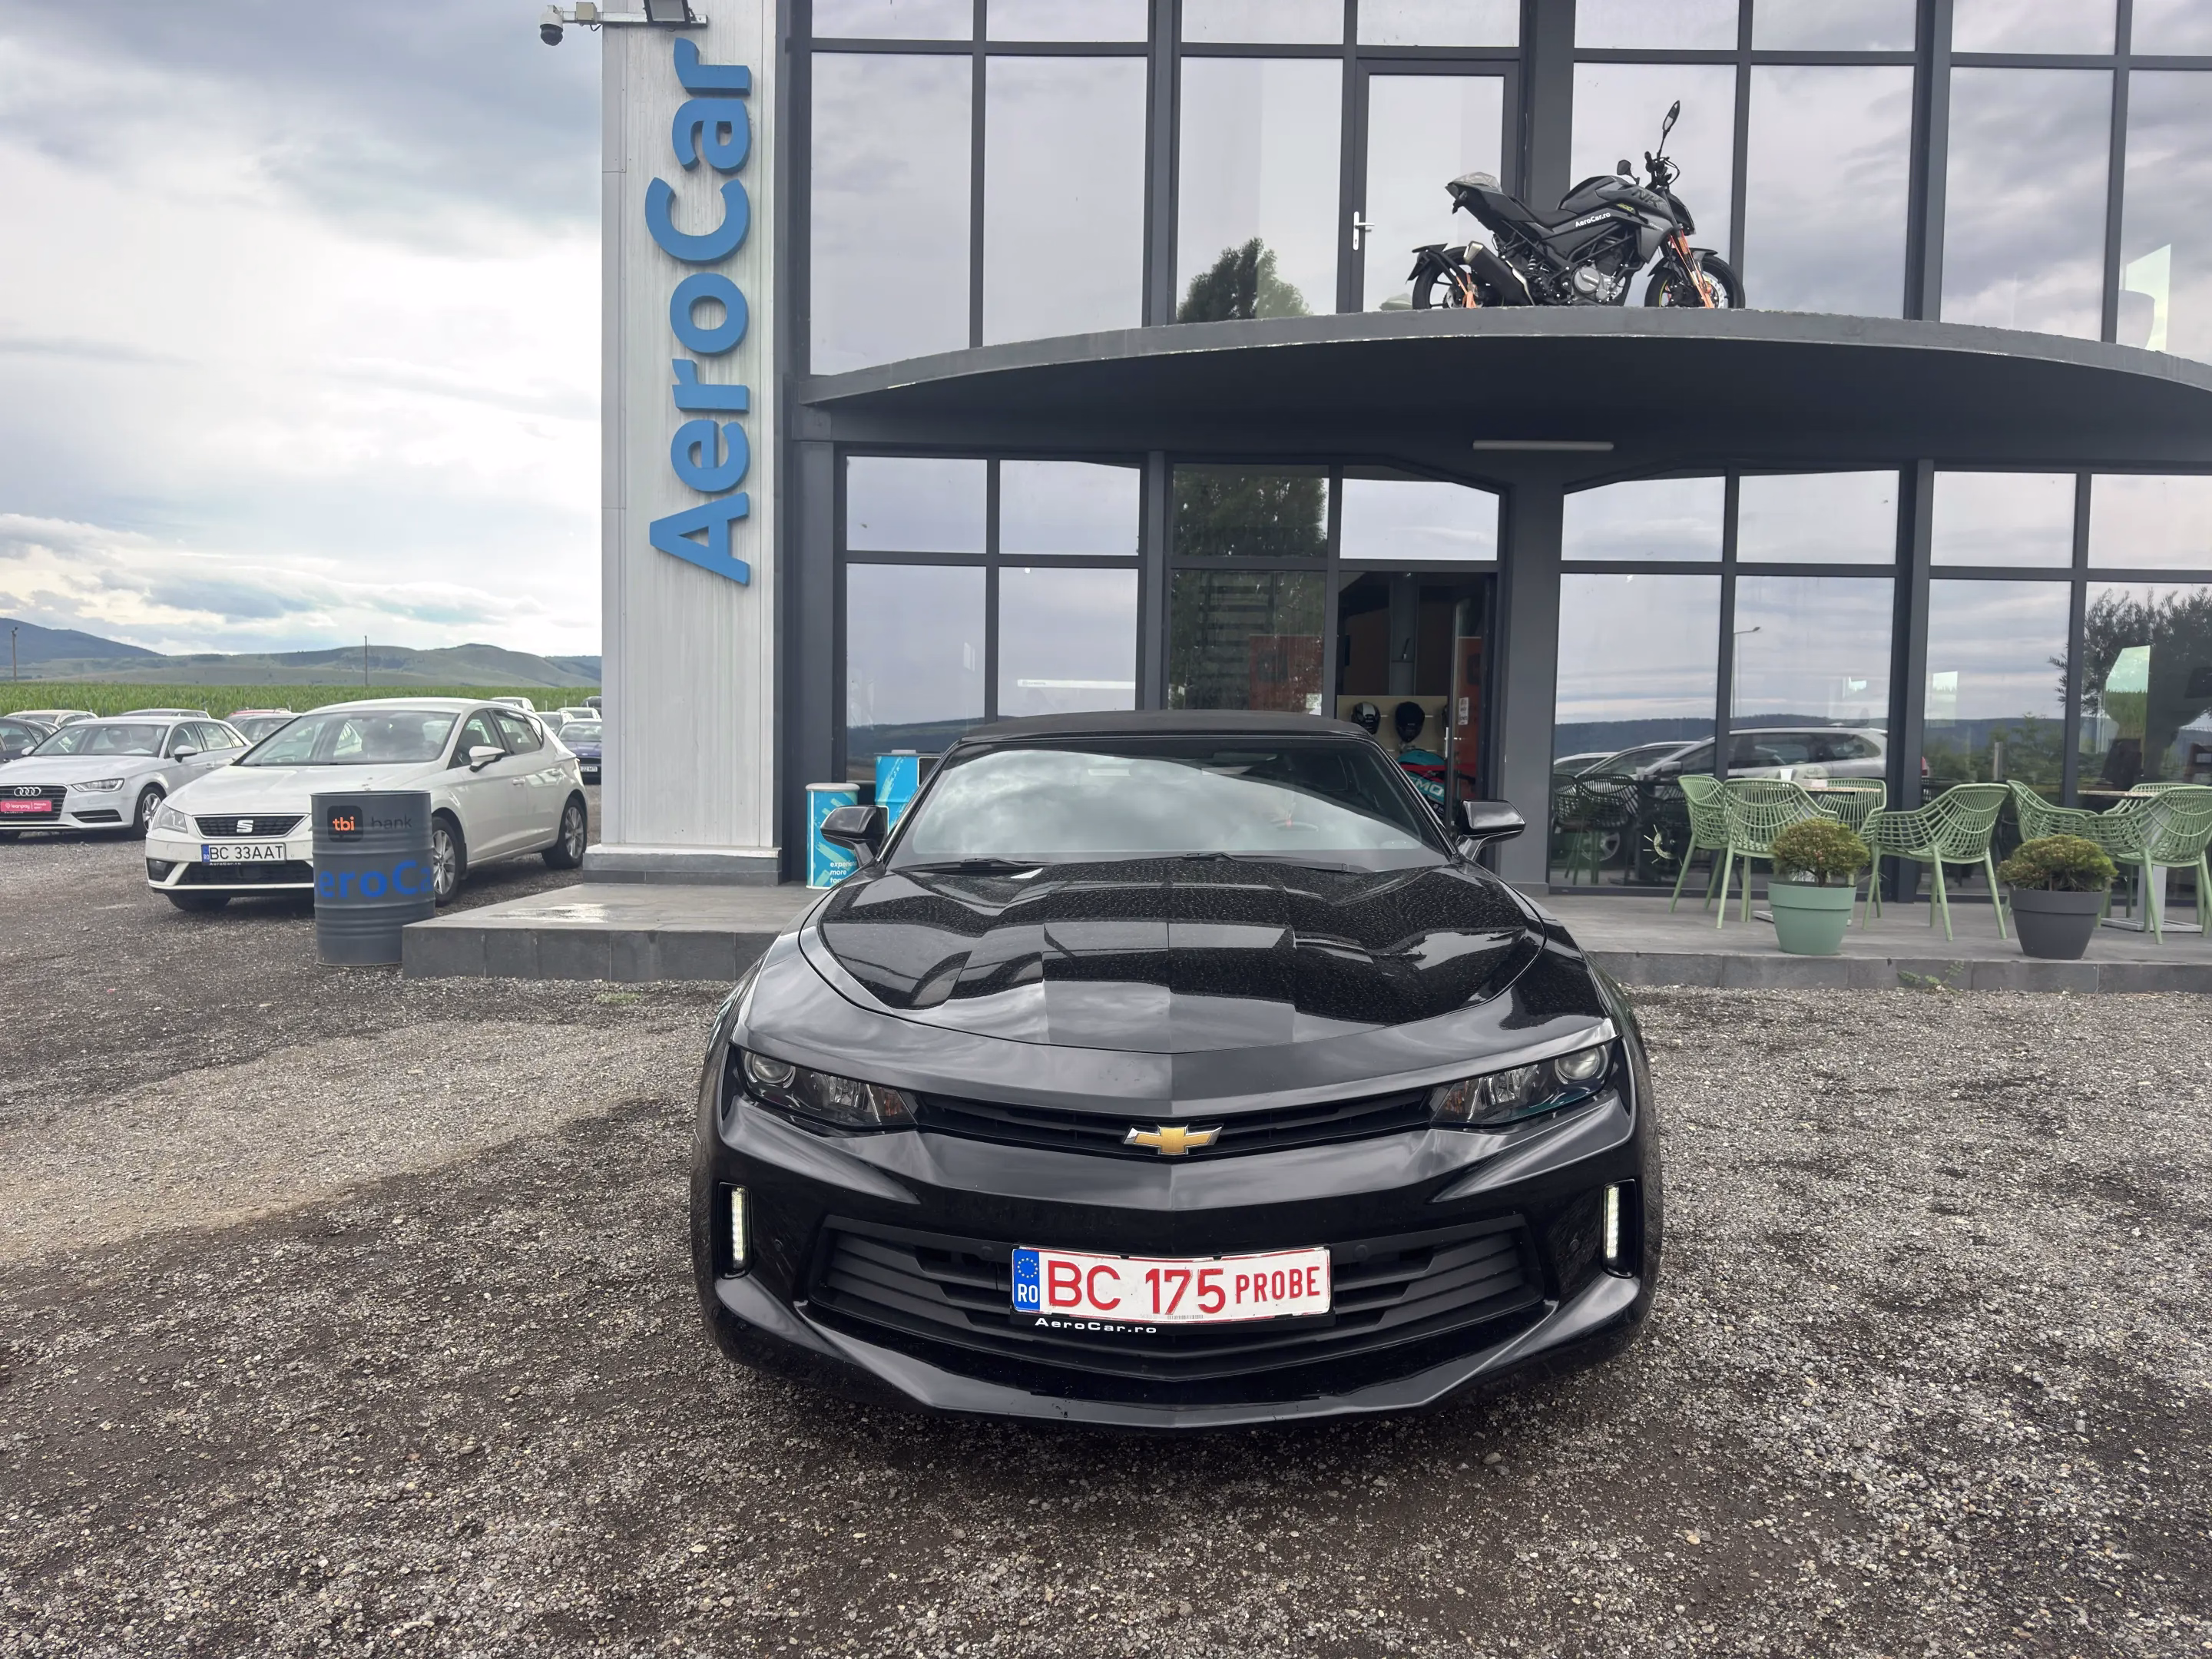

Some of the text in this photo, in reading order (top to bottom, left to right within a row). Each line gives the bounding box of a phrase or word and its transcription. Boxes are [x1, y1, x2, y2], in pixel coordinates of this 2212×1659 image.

[1575, 212, 1611, 227] AeroCar.ro
[644, 37, 752, 586] AeroCar
[332, 813, 412, 831] tbi bank
[210, 846, 283, 859] BC 33AAT
[1018, 1283, 1038, 1303] RO
[1048, 1260, 1321, 1315] BC 175 PROBE
[1035, 1317, 1157, 1334] AeroCar.ro
